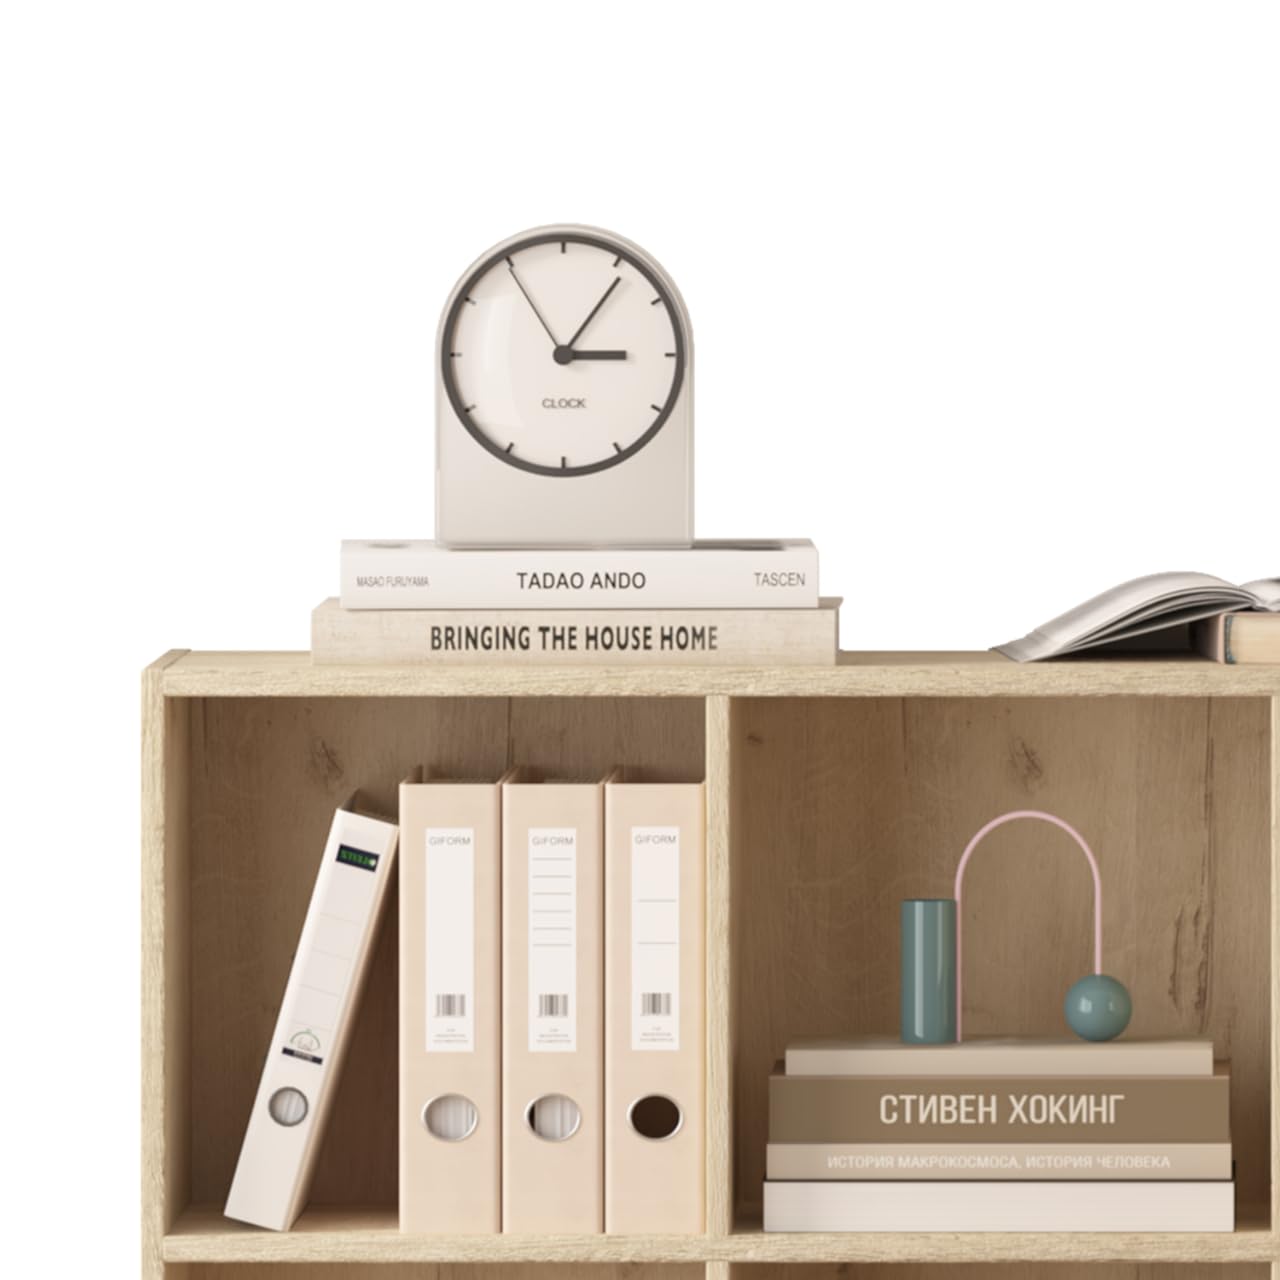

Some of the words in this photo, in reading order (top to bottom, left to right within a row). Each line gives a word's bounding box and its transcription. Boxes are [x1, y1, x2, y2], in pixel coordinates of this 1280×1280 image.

[542, 397, 588, 409] CLOCK
[516, 571, 585, 590] TADAO
[590, 571, 647, 590] ANDO
[754, 572, 807, 588] TASCEN
[430, 625, 531, 651] BRINGING
[538, 625, 578, 651] THE
[585, 625, 653, 651] HOUSE
[660, 625, 719, 651] HOME
[428, 836, 472, 846] GIFORM
[531, 836, 575, 846] GIFORM
[634, 834, 678, 845] GIFORM
[879, 1094, 998, 1125] СТИВЕН
[1008, 1094, 1126, 1125] ХОКИНГ
[827, 1155, 895, 1170] ИСТОРИЯ
[1025, 1155, 1093, 1170] ИСТОРИЯ
[1096, 1155, 1171, 1170] ЧЕЛОВЕКА
